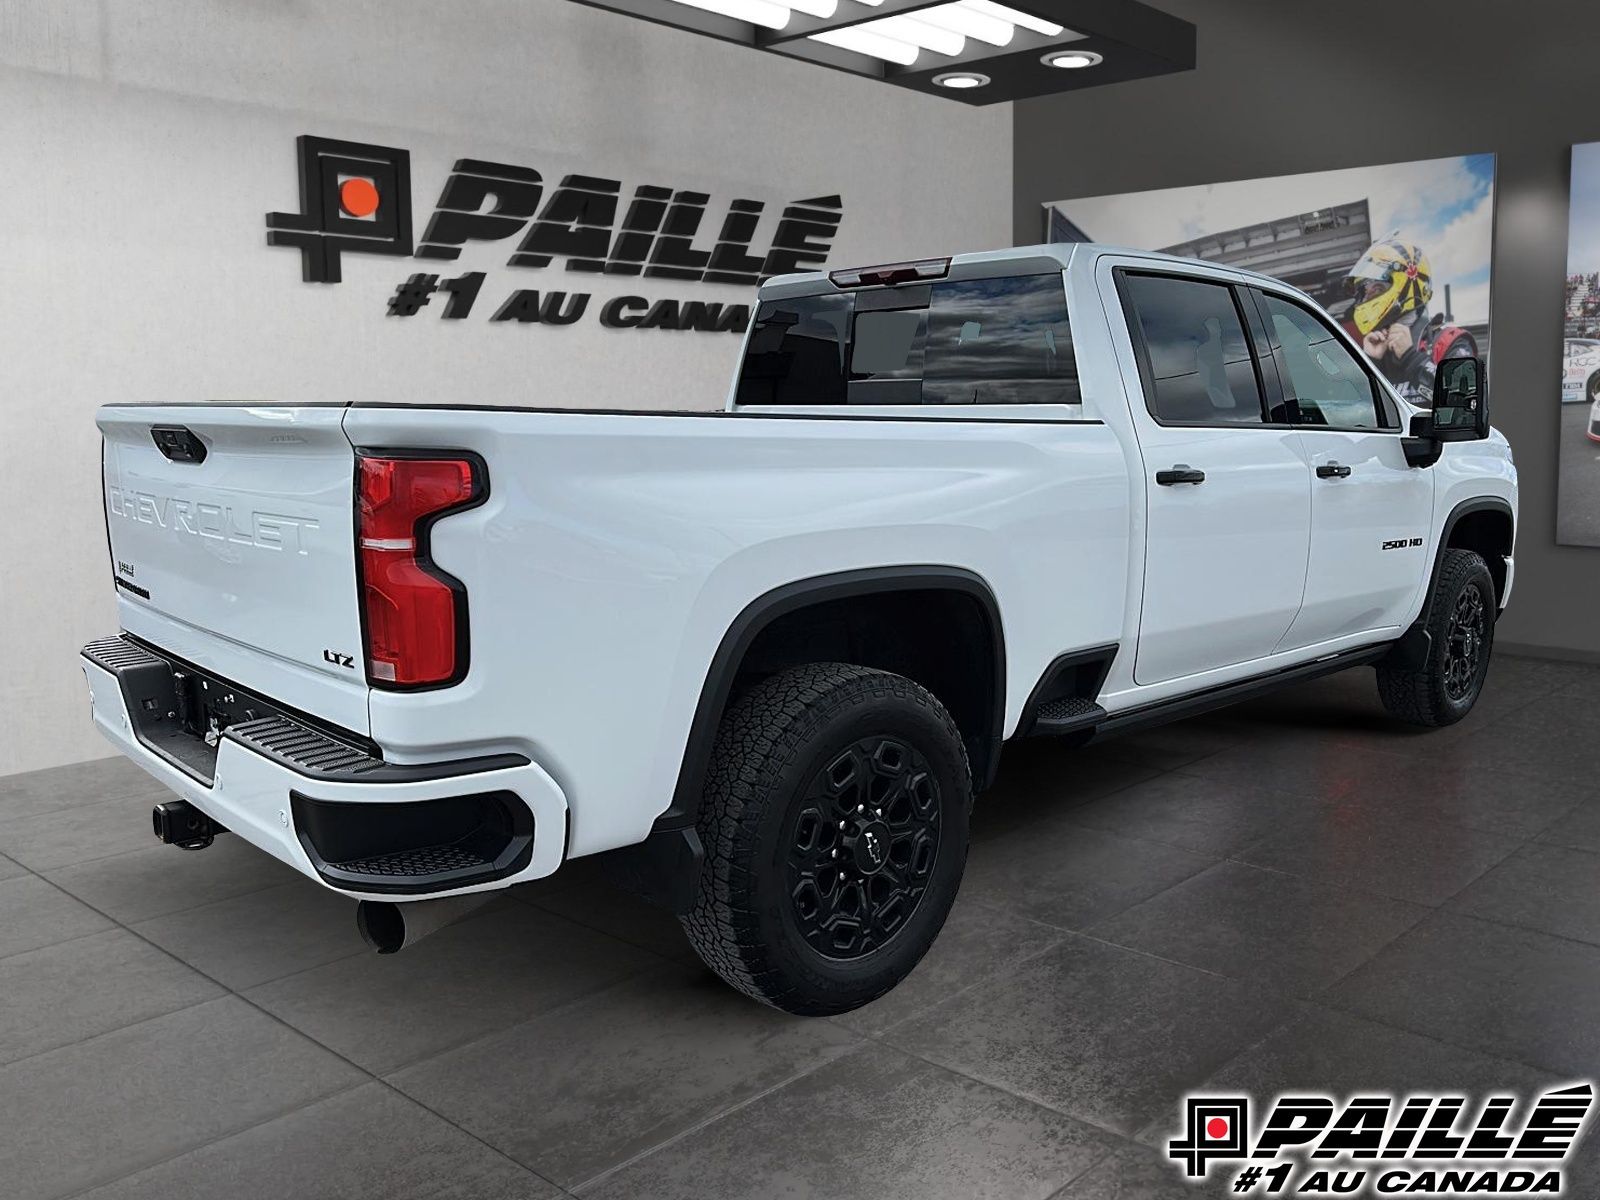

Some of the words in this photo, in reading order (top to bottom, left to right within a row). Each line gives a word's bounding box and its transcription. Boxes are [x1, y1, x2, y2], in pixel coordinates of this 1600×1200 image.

[413, 158, 843, 286] PAILLÉ
[386, 271, 487, 321] #1
[489, 289, 591, 325] AU
[599, 295, 753, 333] CANA
[110, 486, 319, 555] CHEVROLET
[1382, 540, 1407, 550] 2500
[1409, 538, 1423, 547] HD
[324, 650, 354, 669] LTZ
